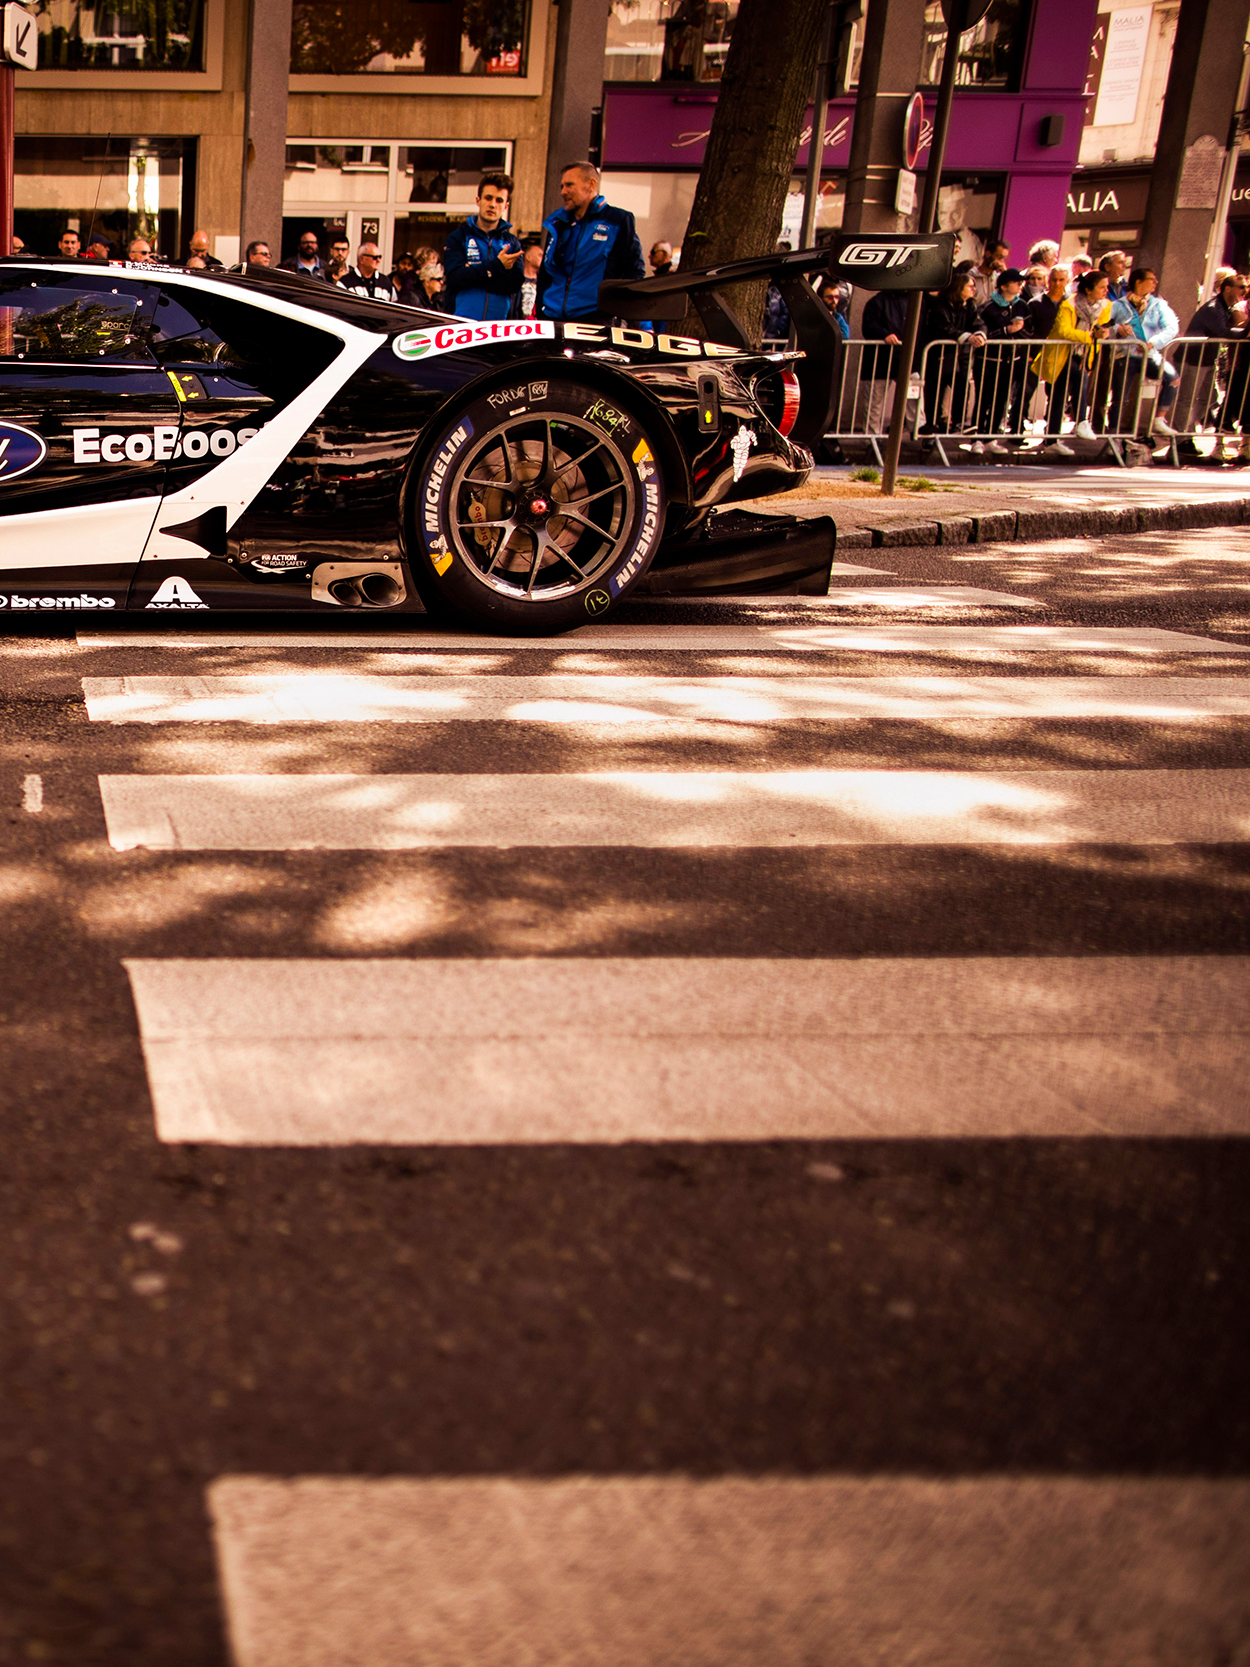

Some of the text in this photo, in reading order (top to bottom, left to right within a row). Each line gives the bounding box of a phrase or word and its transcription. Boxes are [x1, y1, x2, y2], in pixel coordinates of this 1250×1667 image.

[363, 222, 378, 234] 73
[838, 243, 939, 268] GT
[435, 322, 749, 358] Castrol EDGE
[73, 425, 260, 464] EcoBoos
[424, 426, 468, 533] MICHELIN
[615, 483, 658, 589] MICHELIN
[11, 594, 116, 608] brembo
